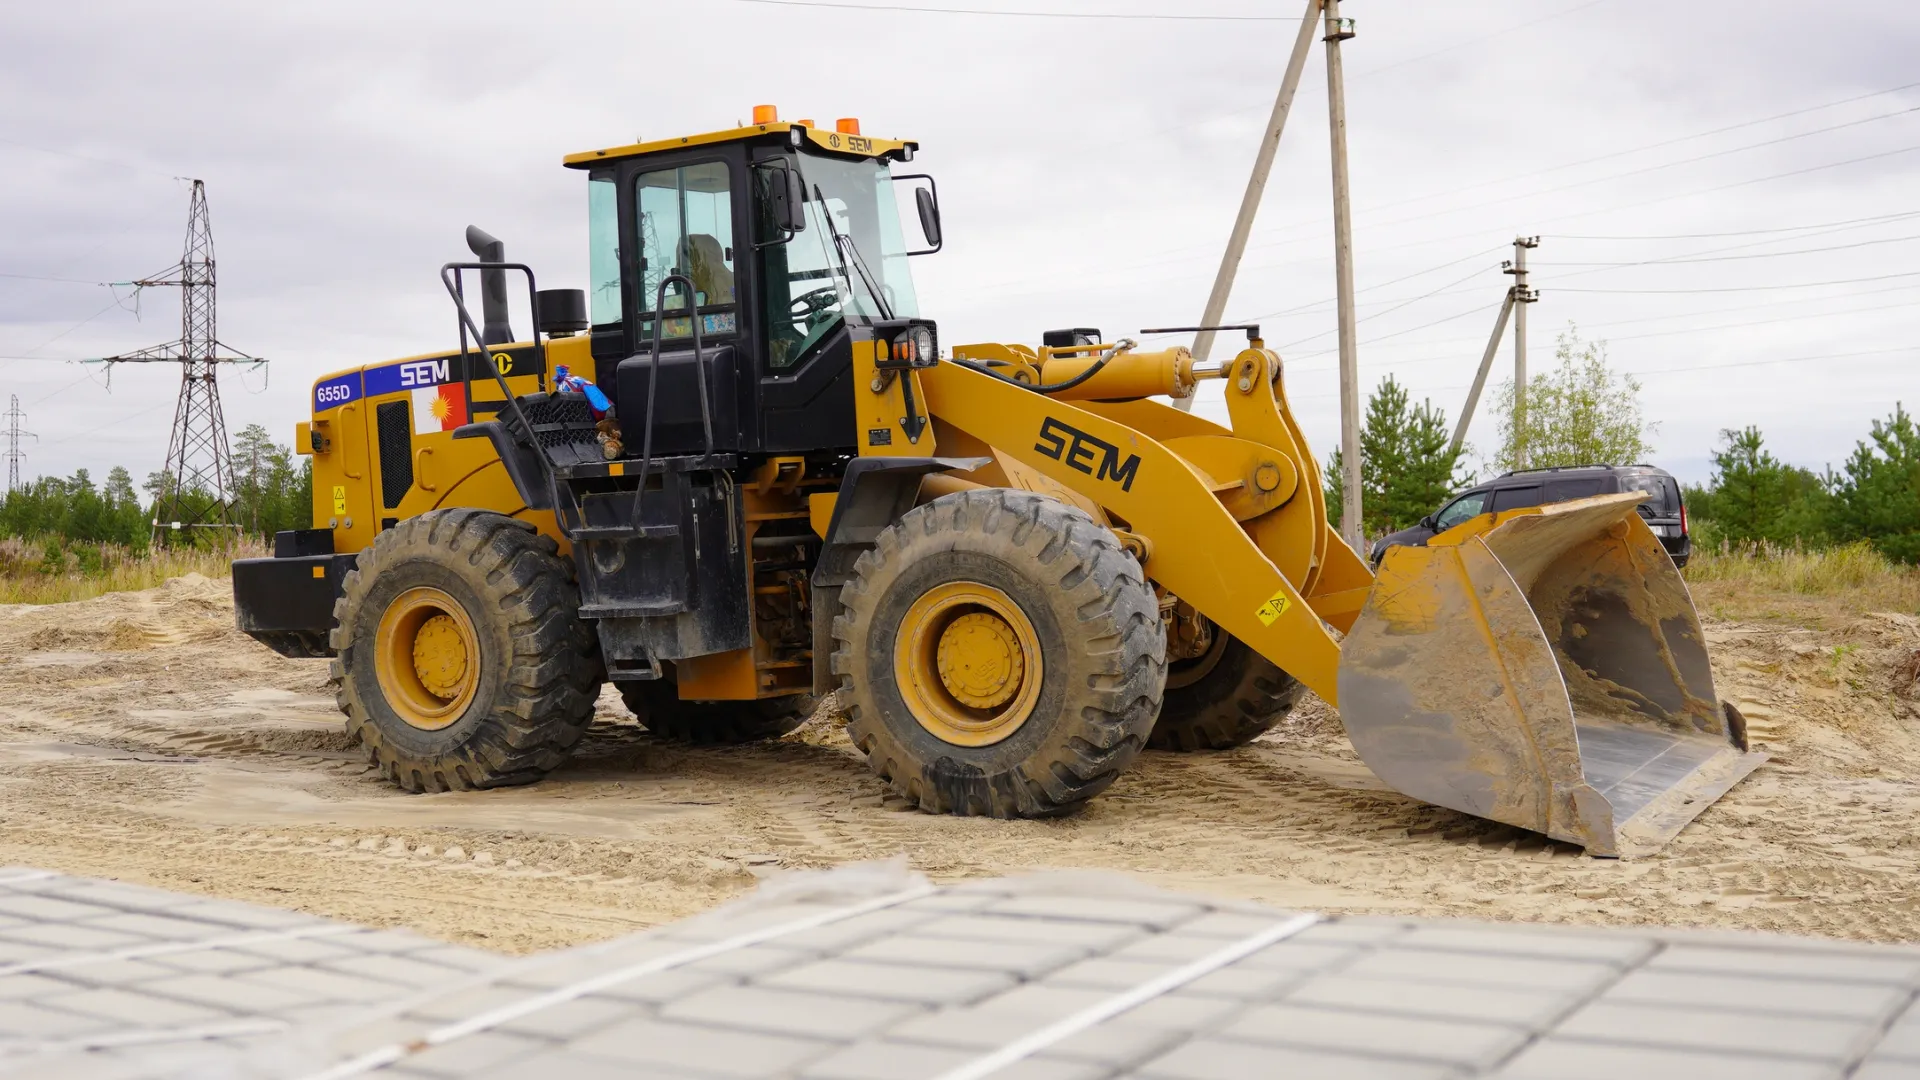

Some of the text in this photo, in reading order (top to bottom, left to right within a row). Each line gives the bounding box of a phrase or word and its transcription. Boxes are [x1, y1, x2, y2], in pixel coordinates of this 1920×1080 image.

[848, 136, 873, 153] SEM
[400, 359, 450, 386] SEM
[317, 384, 351, 403] 655D
[1034, 416, 1142, 493] SEM
